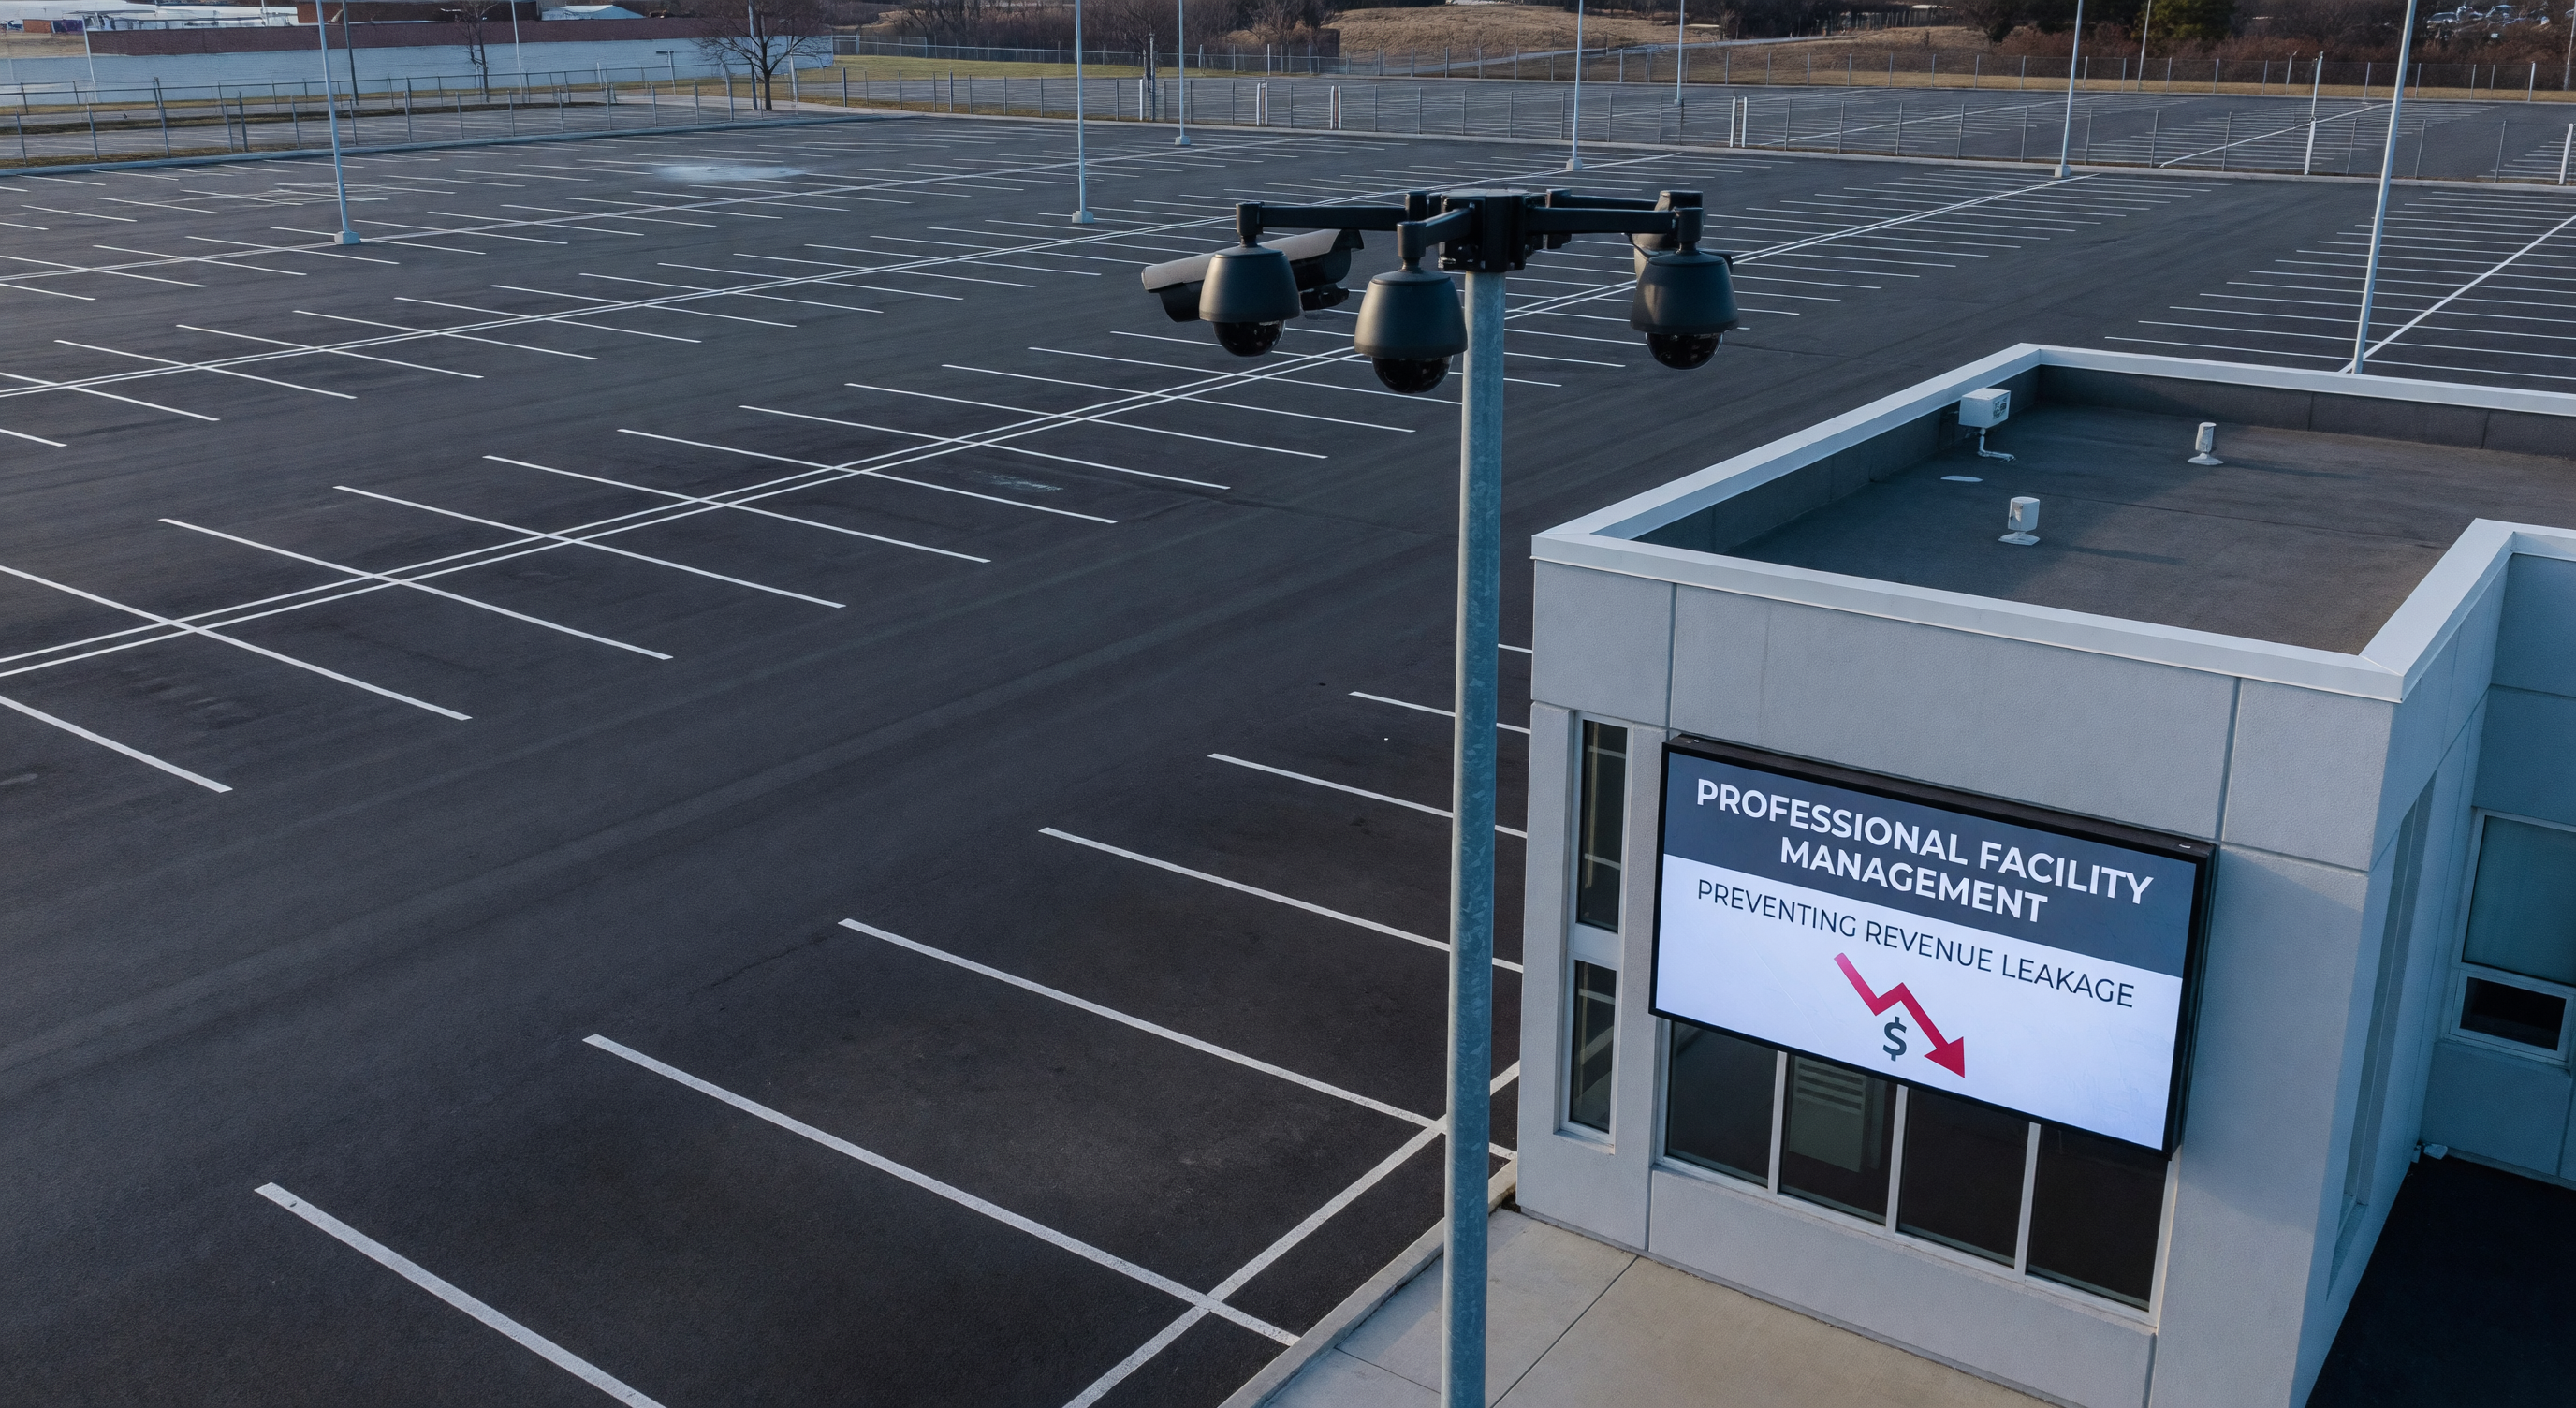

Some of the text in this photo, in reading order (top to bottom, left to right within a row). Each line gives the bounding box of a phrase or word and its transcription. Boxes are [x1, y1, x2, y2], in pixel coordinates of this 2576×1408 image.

[1697, 778, 2154, 904] PROFESSIONAL FACILITY
[1780, 837, 2048, 923] MANAGEMENT
[1698, 879, 2135, 1007] PREVENTING REVENUE LEAKAGE
[1882, 1016, 1908, 1061] $
